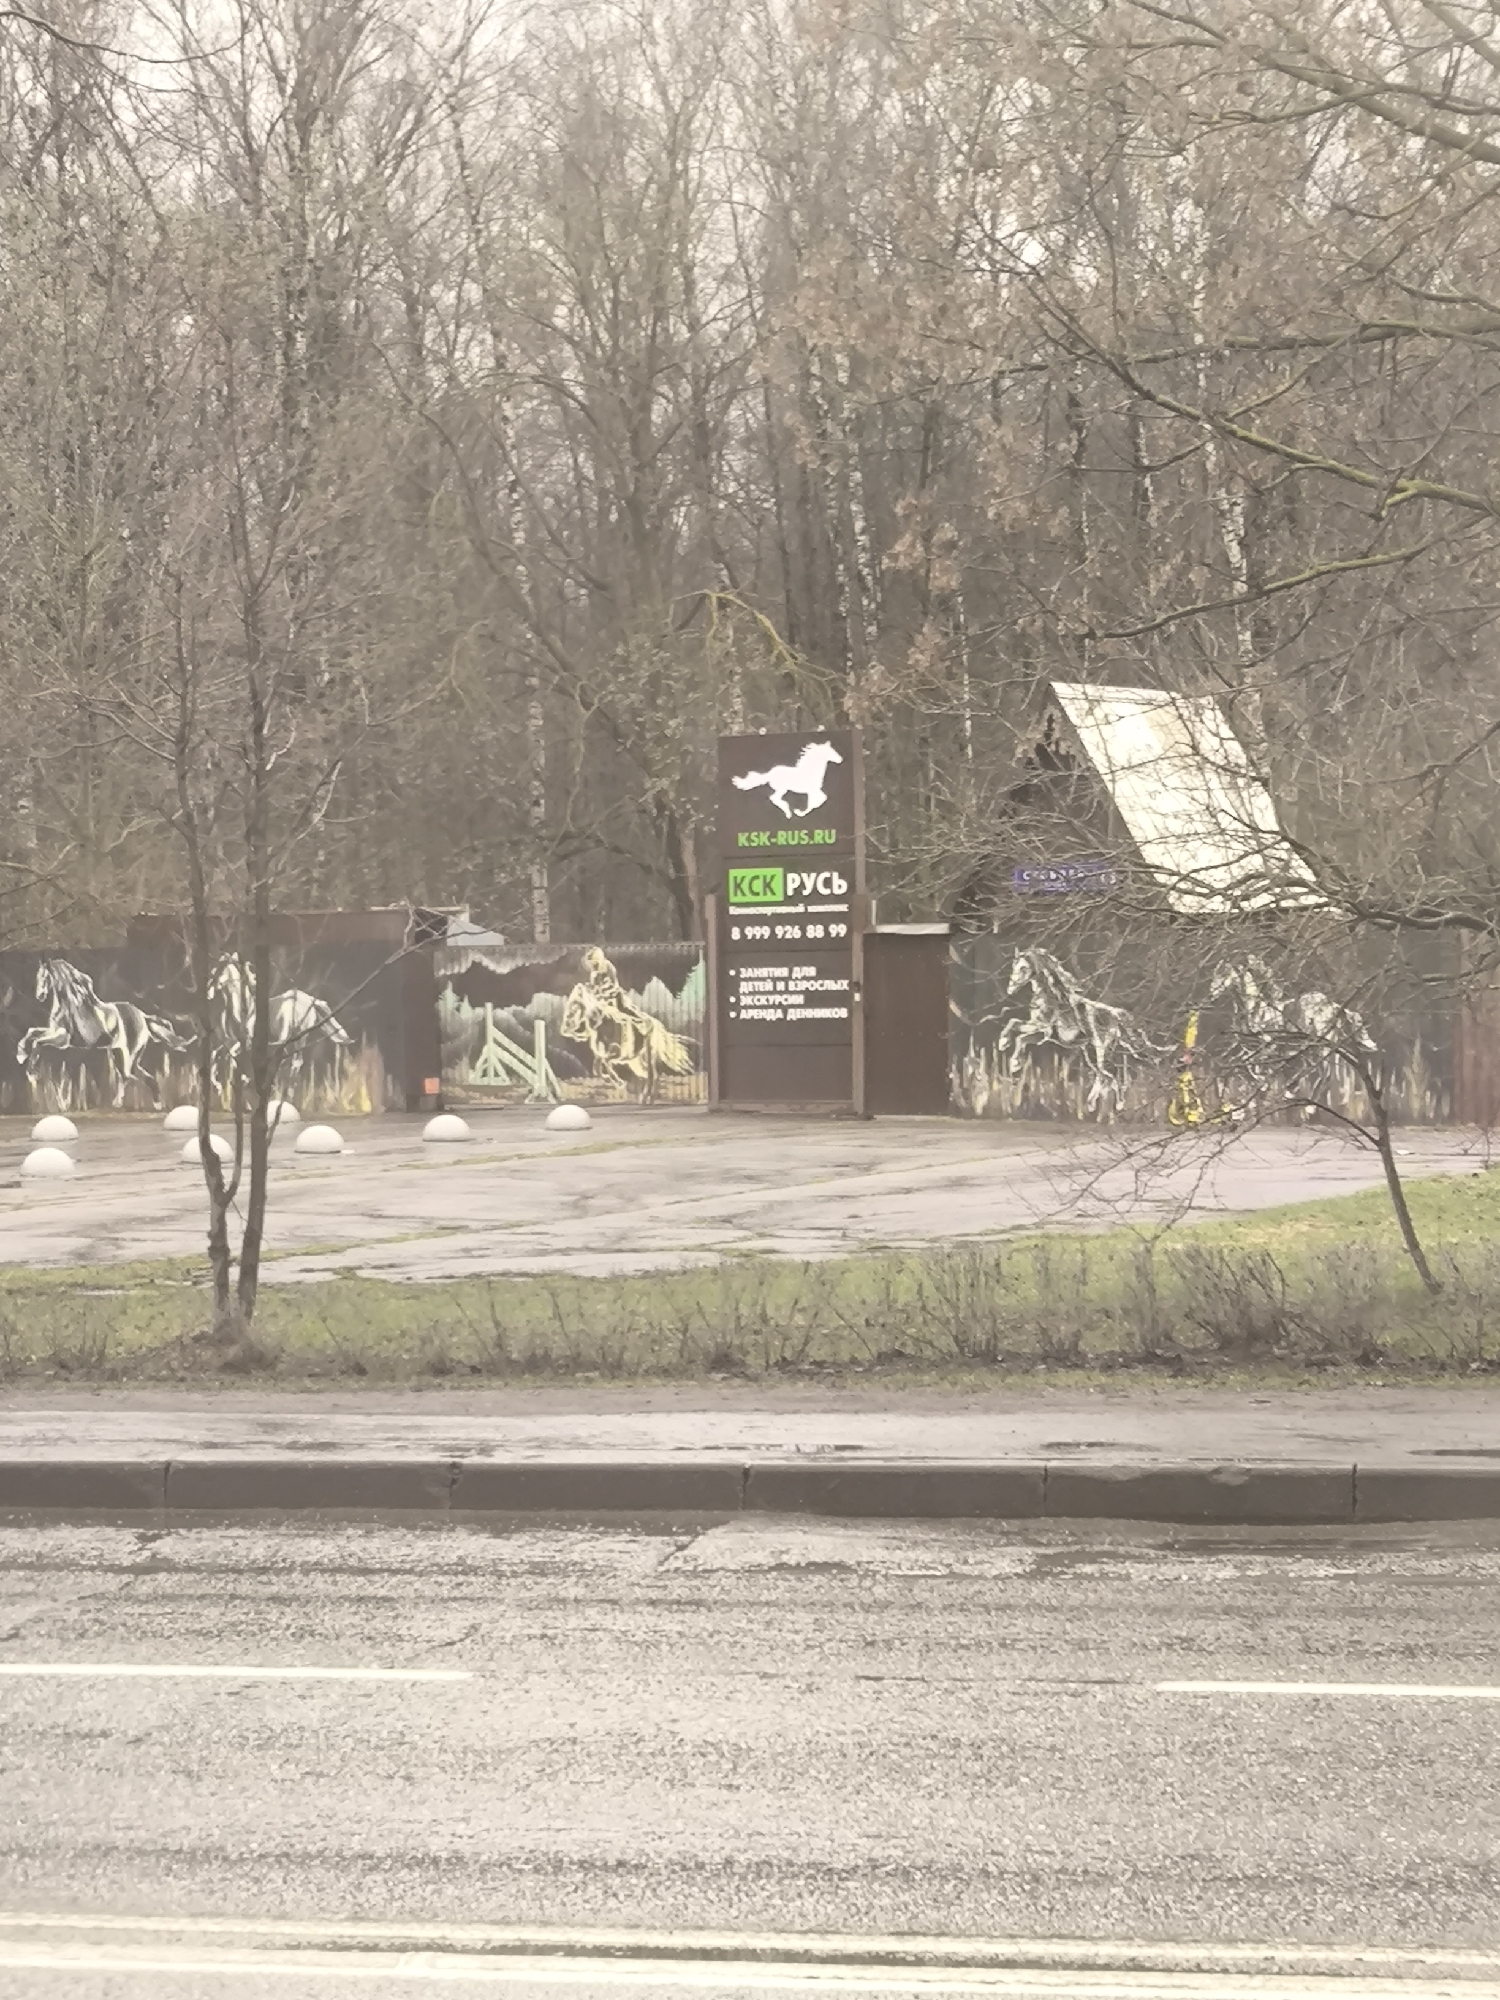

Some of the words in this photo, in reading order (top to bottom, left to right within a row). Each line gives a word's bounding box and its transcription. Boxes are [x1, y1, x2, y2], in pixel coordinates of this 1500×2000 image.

[738, 829, 837, 847] KSK-RUS.RU
[732, 874, 777, 897] КСК
[786, 871, 848, 896] РУСЬ
[731, 926, 741, 940] 8
[744, 925, 771, 940] 999
[774, 925, 802, 939] 926
[805, 924, 825, 939] 88
[828, 923, 847, 938] 99
[739, 967, 789, 978] ЗАНЯТИЯ
[791, 966, 817, 979] ДЛЯ
[739, 979, 774, 994] ДЕТЕЙ
[775, 981, 786, 991] И
[788, 979, 849, 991] ВЗРОСЛЫХ
[739, 1008, 784, 1021] АРЕНДА
